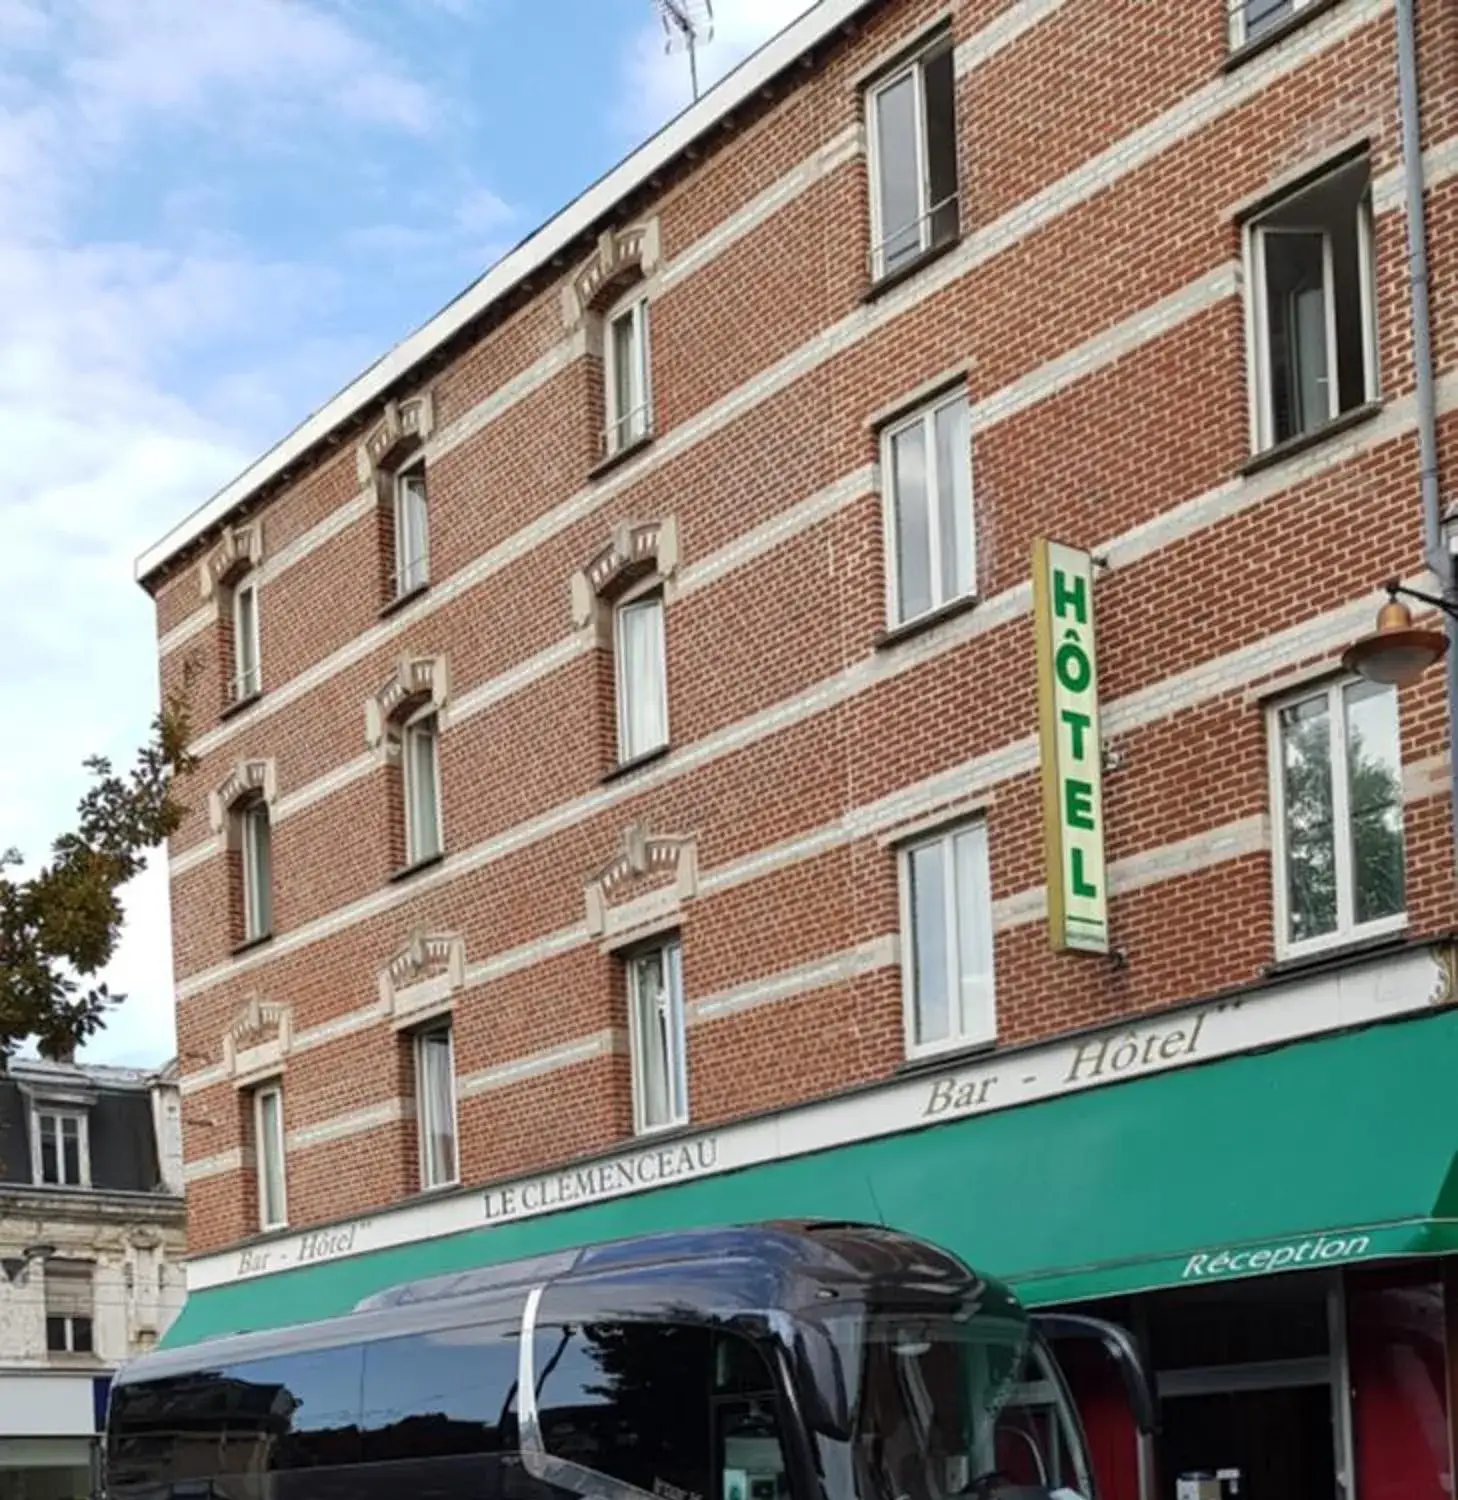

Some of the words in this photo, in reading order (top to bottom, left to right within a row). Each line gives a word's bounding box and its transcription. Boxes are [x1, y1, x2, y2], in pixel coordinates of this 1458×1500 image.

[1053, 569, 1097, 899] HÔTEL
[922, 1075, 997, 1117] Bar
[484, 1192, 516, 1219] LE
[237, 1250, 271, 1274] Bar
[1181, 1234, 1371, 1279] Réception
